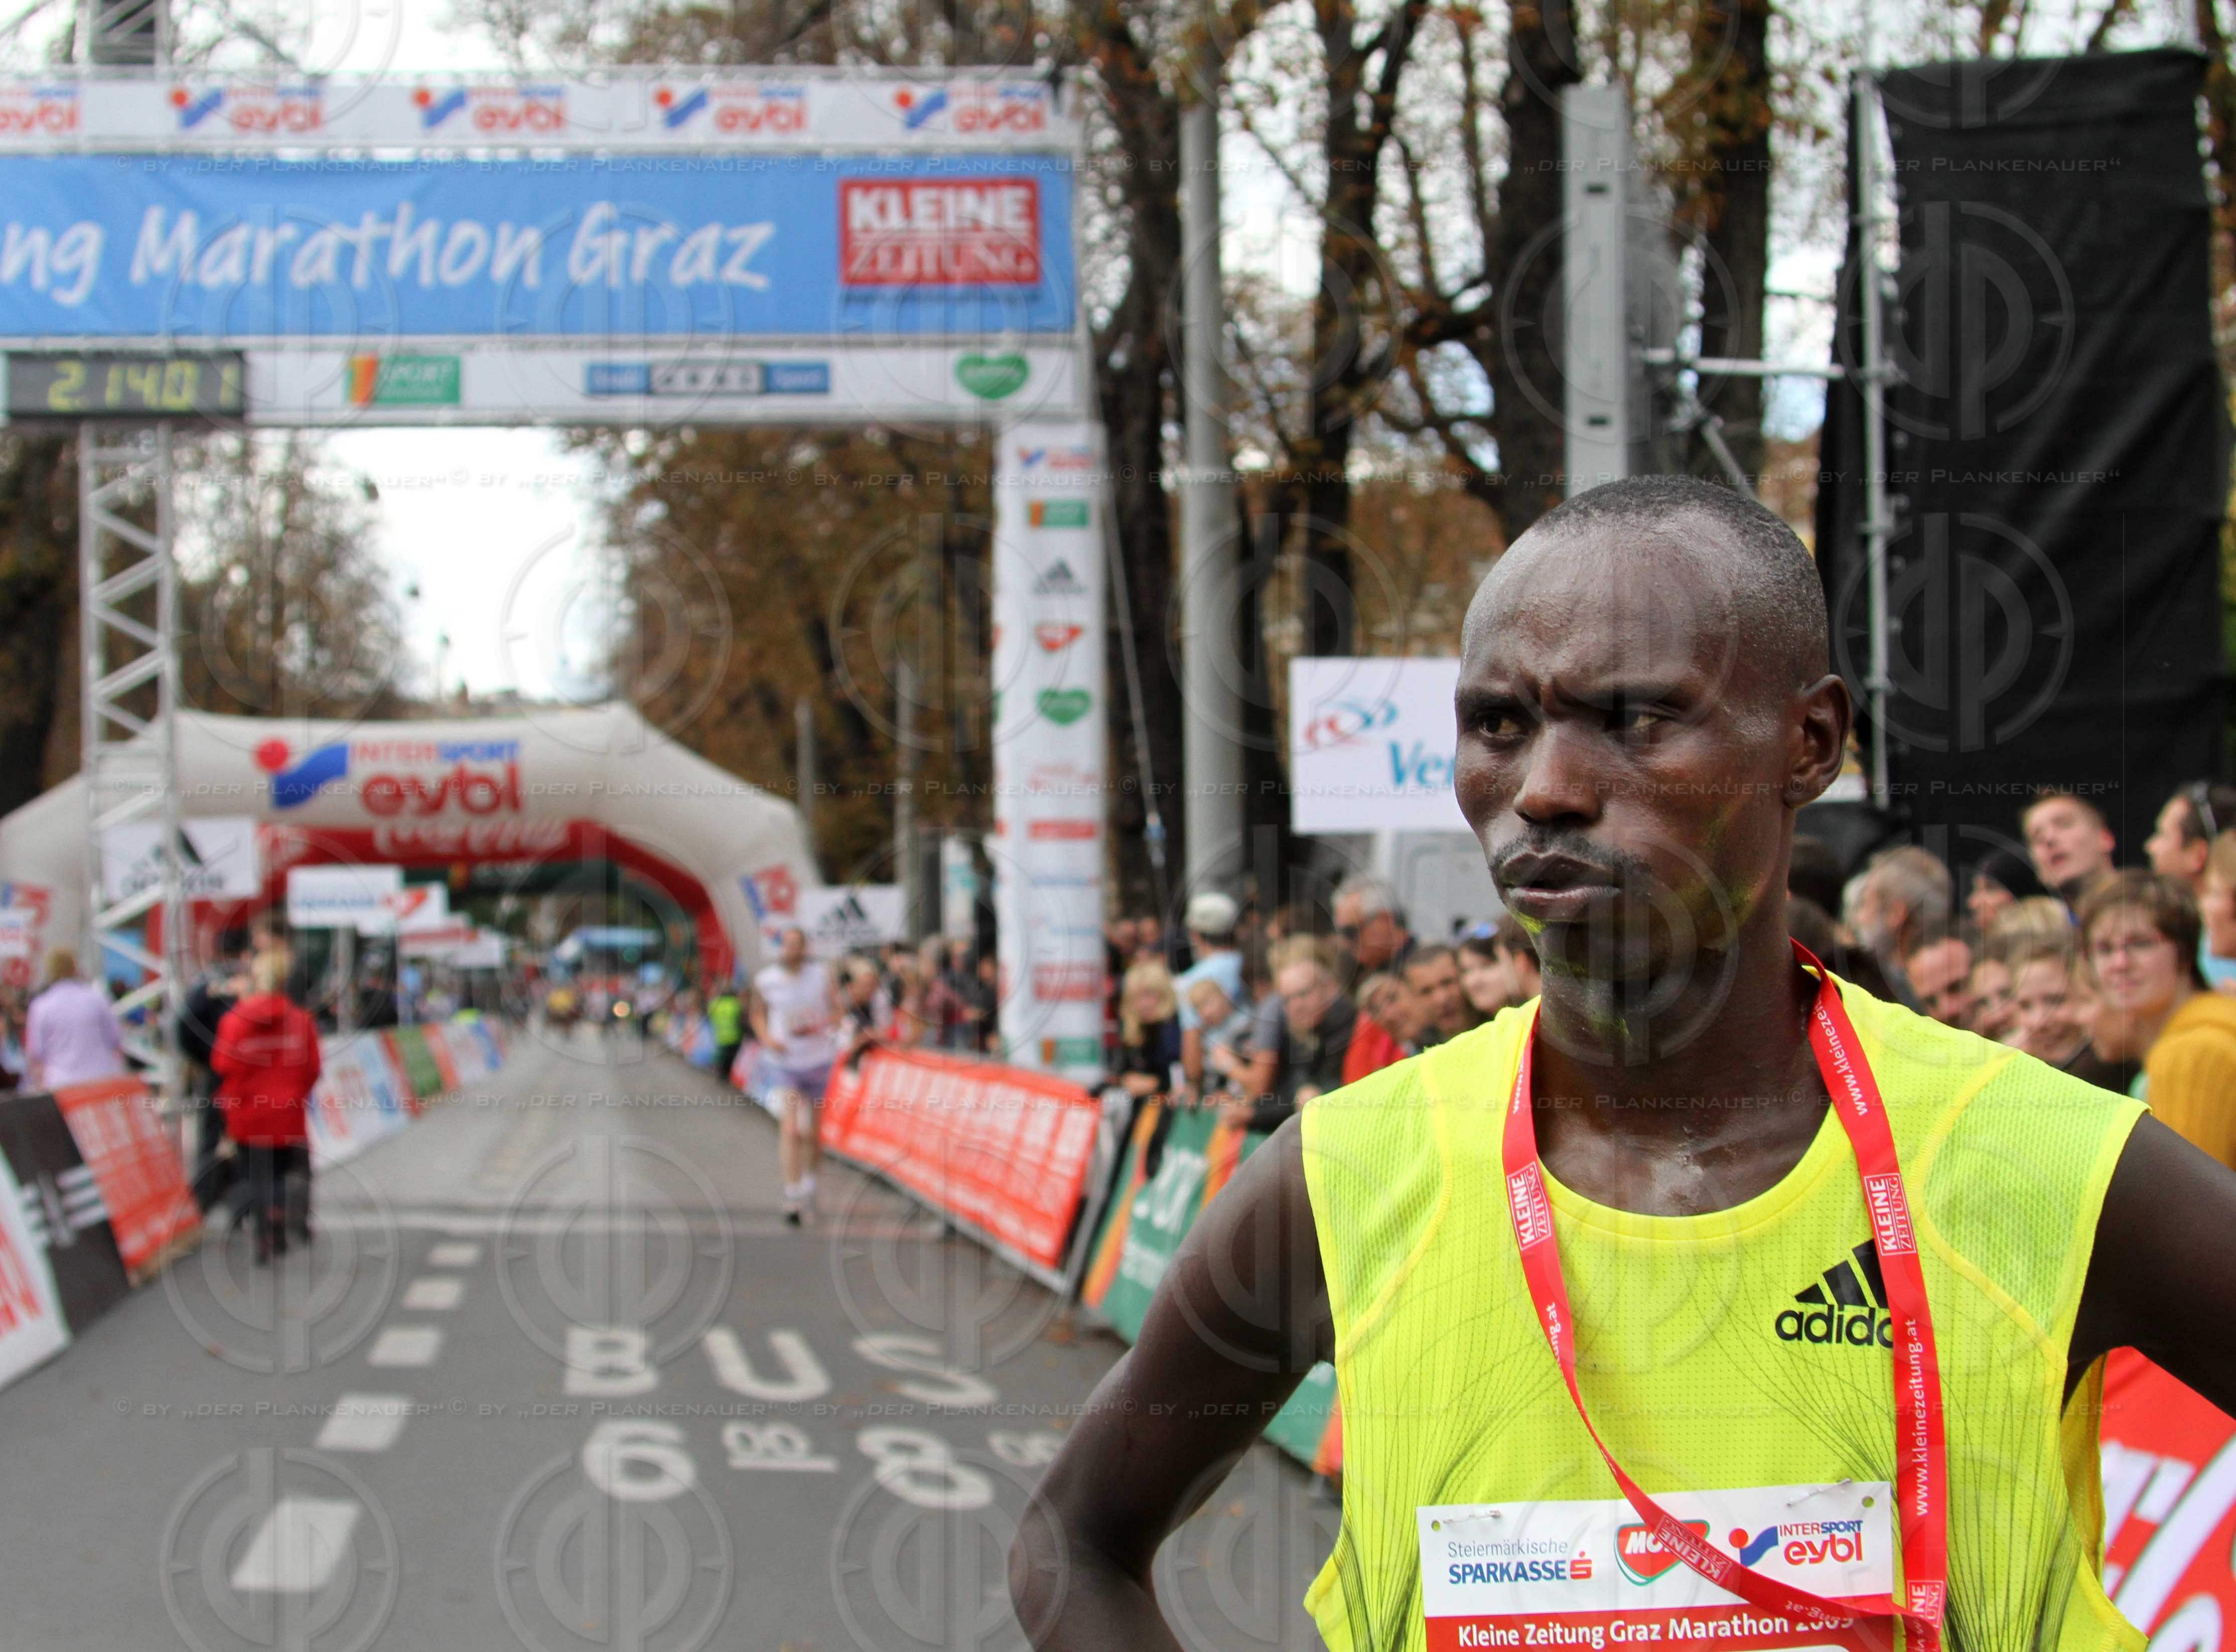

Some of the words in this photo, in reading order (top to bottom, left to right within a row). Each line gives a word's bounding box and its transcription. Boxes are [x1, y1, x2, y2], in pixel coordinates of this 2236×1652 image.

[846, 186, 1033, 232] KLEINE
[129, 200, 543, 291] Marathon
[566, 200, 777, 293] Graz
[361, 760, 522, 817] eybl
[1509, 1173, 1534, 1245] KLEINE
[1524, 1166, 1551, 1236] ZEITUNG
[1868, 1177, 1898, 1252] KLEINE
[1888, 1176, 1912, 1250] ZEITUNG
[1775, 1303, 1894, 1348] adid
[562, 1325, 1000, 1409] BUS
[1907, 1318, 1928, 1517] www.kleinezeitung.at
[1447, 1538, 1569, 1558] Steiermärkische
[1625, 1531, 1671, 1555] MO
[1779, 1520, 1863, 1537] INTERSPORT
[1783, 1532, 1863, 1565] eybl
[1448, 1560, 1567, 1585] SPARKASSE
[1458, 1622, 1520, 1647] Kleine
[1523, 1621, 1605, 1650] Zeitung
[1609, 1619, 1662, 1643] Graz
[1668, 1613, 1788, 1640] Marathon
